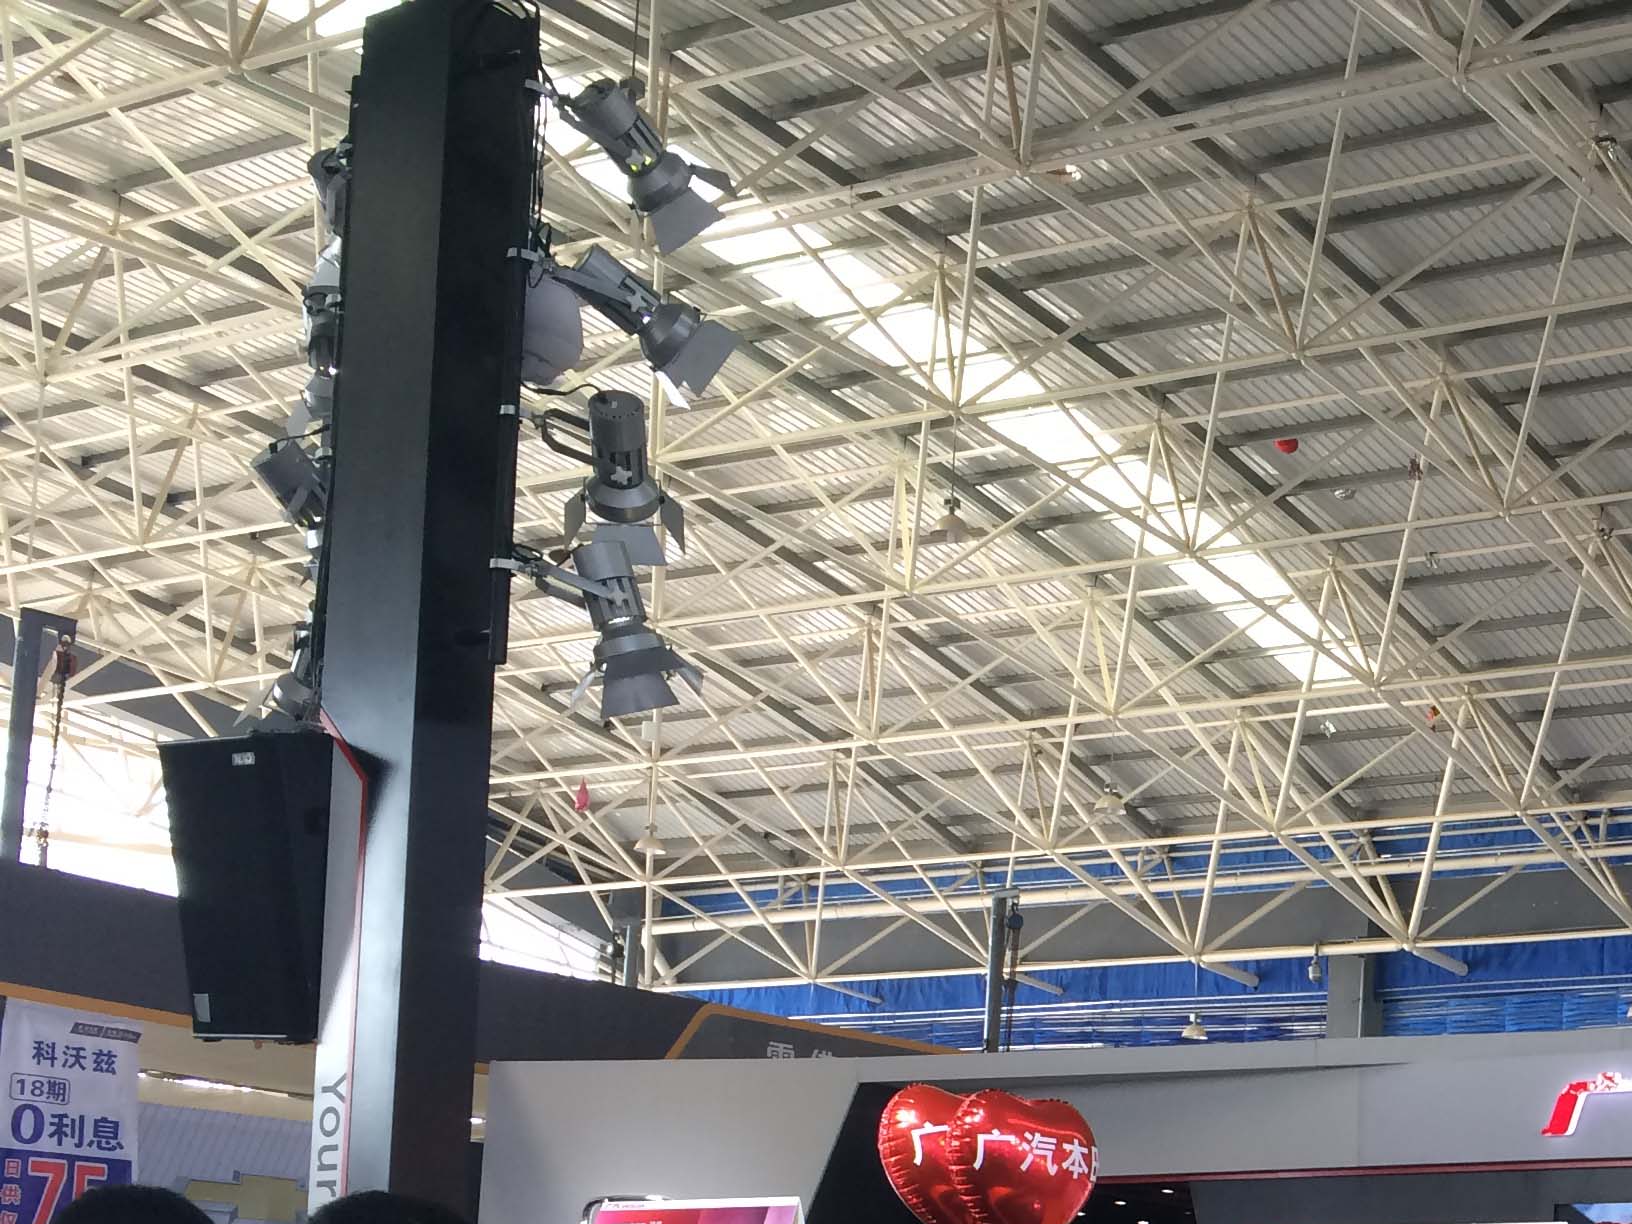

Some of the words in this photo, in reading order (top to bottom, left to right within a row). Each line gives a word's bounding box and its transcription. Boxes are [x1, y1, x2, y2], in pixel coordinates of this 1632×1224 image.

[32, 1040, 118, 1075] 科沃兹
[16, 1078, 67, 1102] 18期
[11, 1103, 125, 1152] 0利息
[317, 1073, 348, 1198] Your
[911, 1121, 950, 1166] 广
